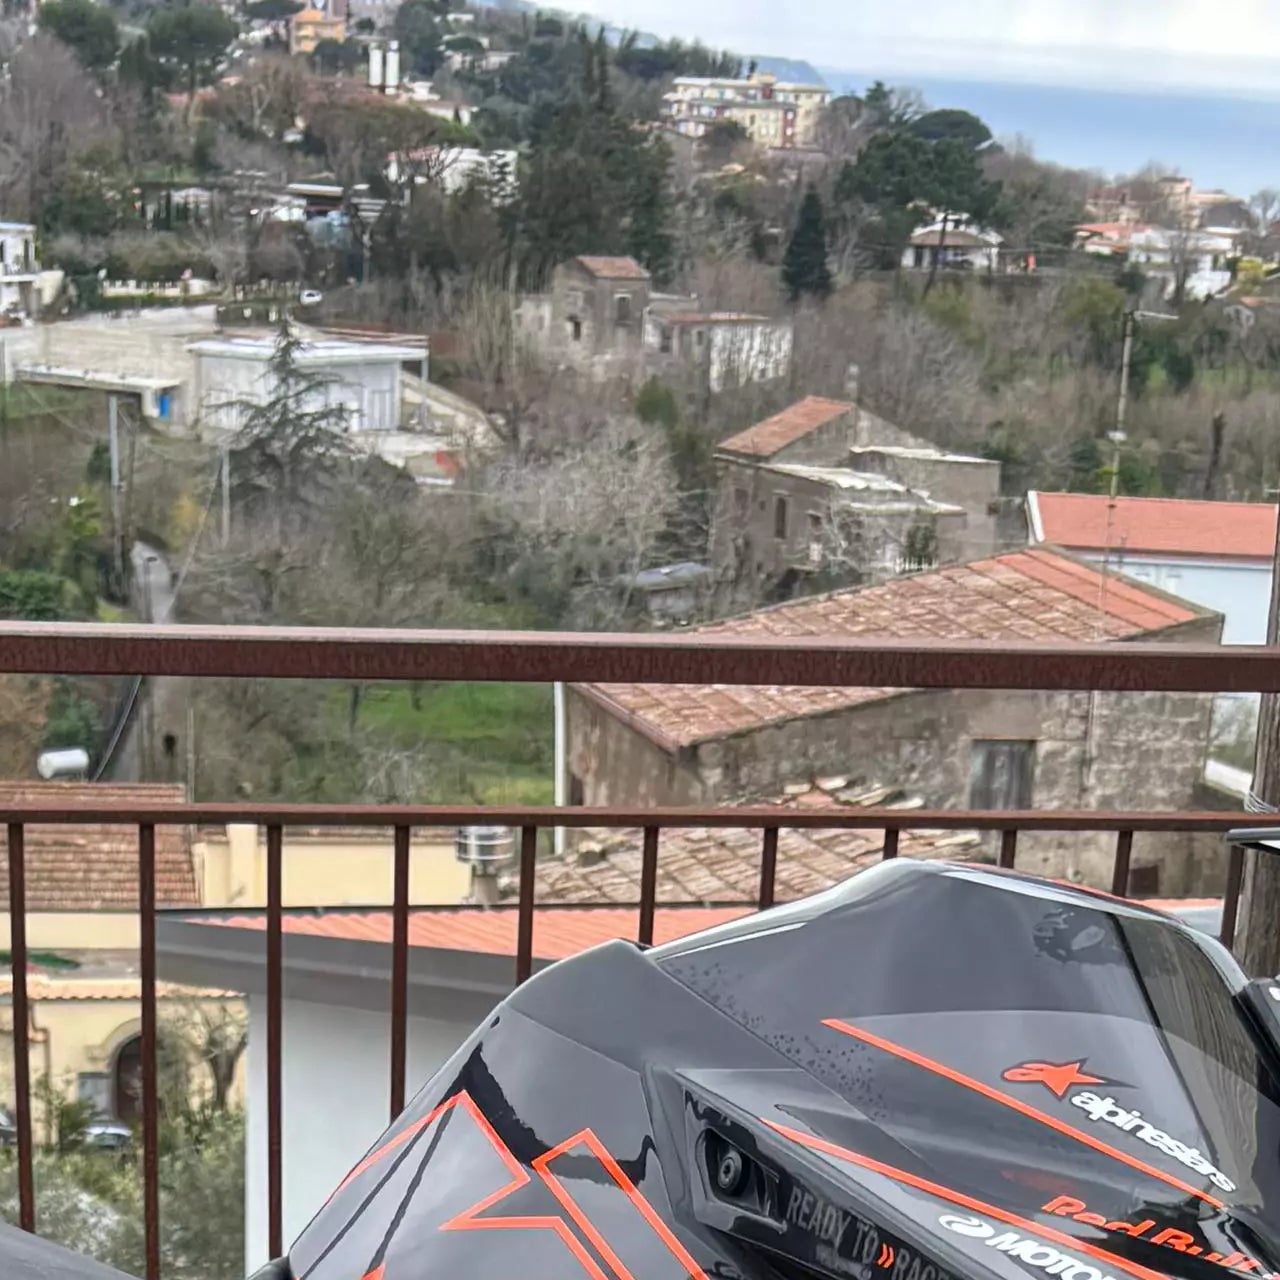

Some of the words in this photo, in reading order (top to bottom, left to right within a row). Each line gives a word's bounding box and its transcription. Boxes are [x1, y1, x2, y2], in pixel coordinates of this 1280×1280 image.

[1070, 1089, 1237, 1192] alpinestars
[786, 1185, 851, 1249] READY
[852, 1221, 879, 1265] TO
[1041, 1195, 1154, 1238] Red
